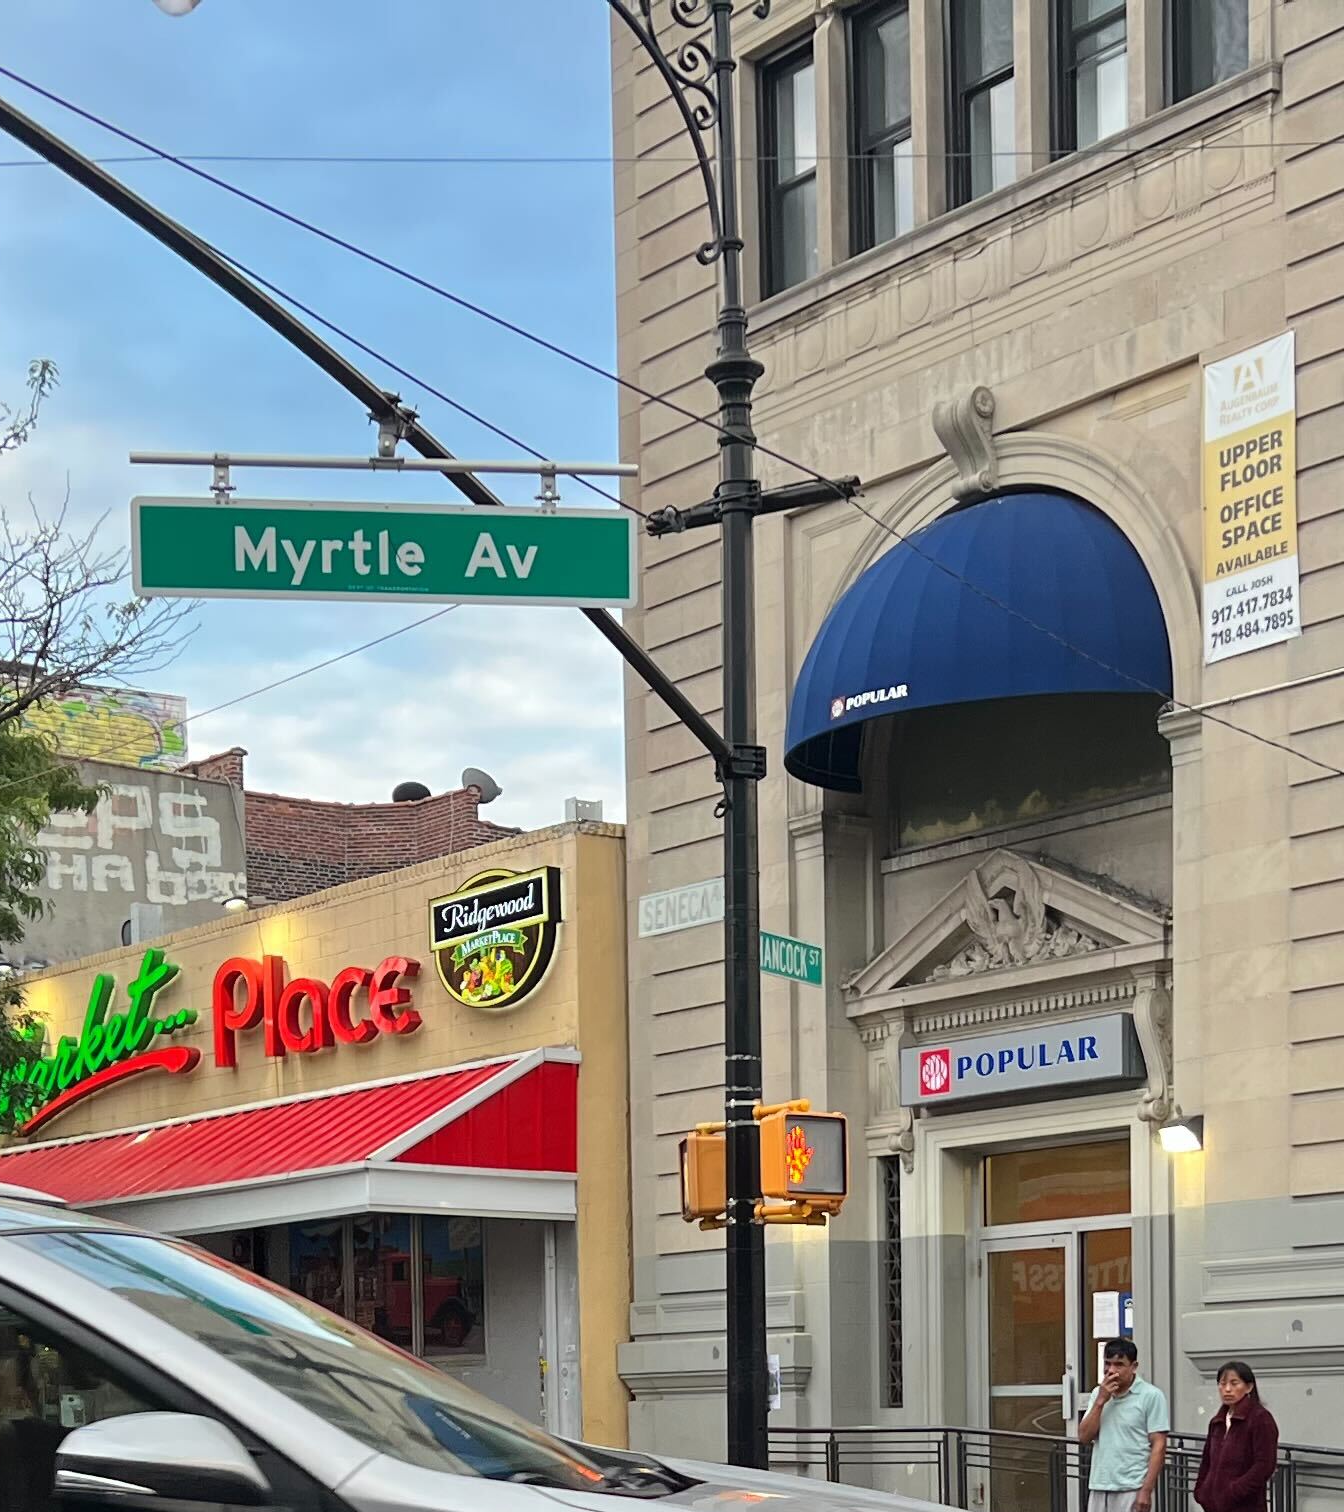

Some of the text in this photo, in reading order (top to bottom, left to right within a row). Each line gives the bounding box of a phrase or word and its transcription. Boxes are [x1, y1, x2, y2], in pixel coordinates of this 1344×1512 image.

[1219, 430, 1283, 468] UPPER
[1220, 454, 1282, 492] FLOOR
[1220, 486, 1284, 523] OFFICE
[1221, 512, 1282, 549] SPACE
[233, 525, 538, 586] Myrtle Av
[1216, 541, 1288, 576] AVAILABLE
[1211, 586, 1293, 625] 917.417.7834
[1225, 575, 1273, 598] CALL JOSH
[1211, 610, 1294, 648] 718.484.7895
[845, 684, 908, 711] POPULAR
[441, 882, 535, 933] Ridgewood
[642, 887, 712, 931] SENECA
[808, 949, 820, 967] ST
[957, 1036, 1099, 1080] POPULAR
